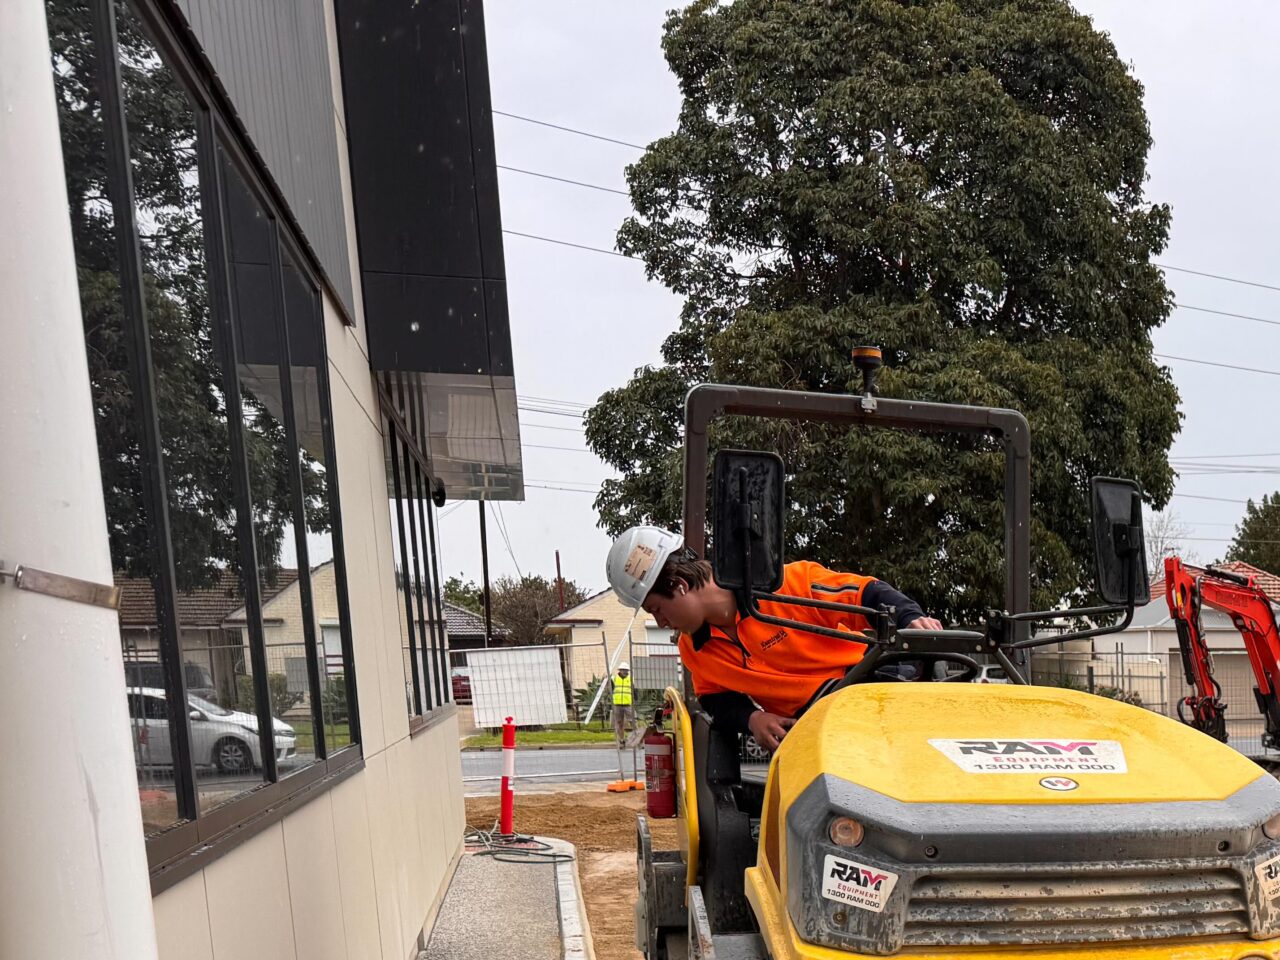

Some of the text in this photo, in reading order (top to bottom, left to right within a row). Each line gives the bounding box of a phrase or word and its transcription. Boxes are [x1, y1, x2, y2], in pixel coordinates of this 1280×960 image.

[954, 741, 1098, 755] RAM
[1077, 763, 1116, 771] 000
[830, 861, 889, 891] RAM
[826, 888, 880, 909] 1300 RAM 000
[837, 882, 879, 900] EQUIPMENT
